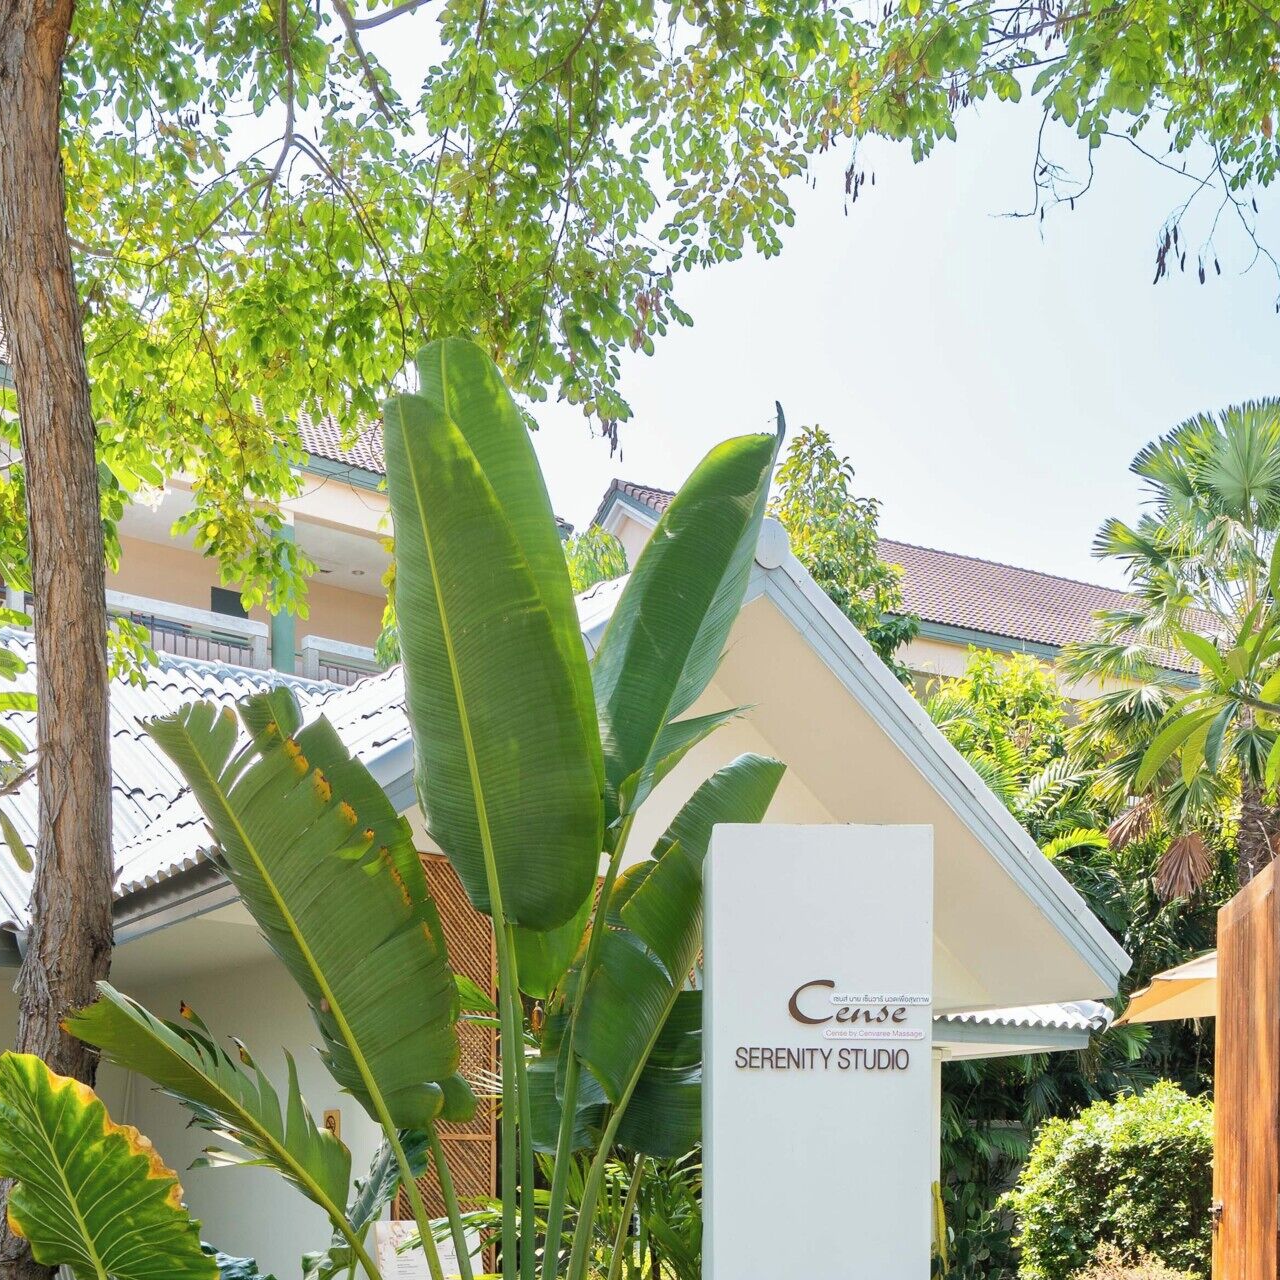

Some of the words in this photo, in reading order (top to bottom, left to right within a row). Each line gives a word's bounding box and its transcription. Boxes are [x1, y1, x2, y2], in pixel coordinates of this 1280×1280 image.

[788, 979, 907, 1025] Cense
[825, 1029, 848, 1037] Cense
[892, 1030, 923, 1039] Massage
[734, 1046, 833, 1070] SERENITY
[837, 1048, 910, 1071] STUDIO
